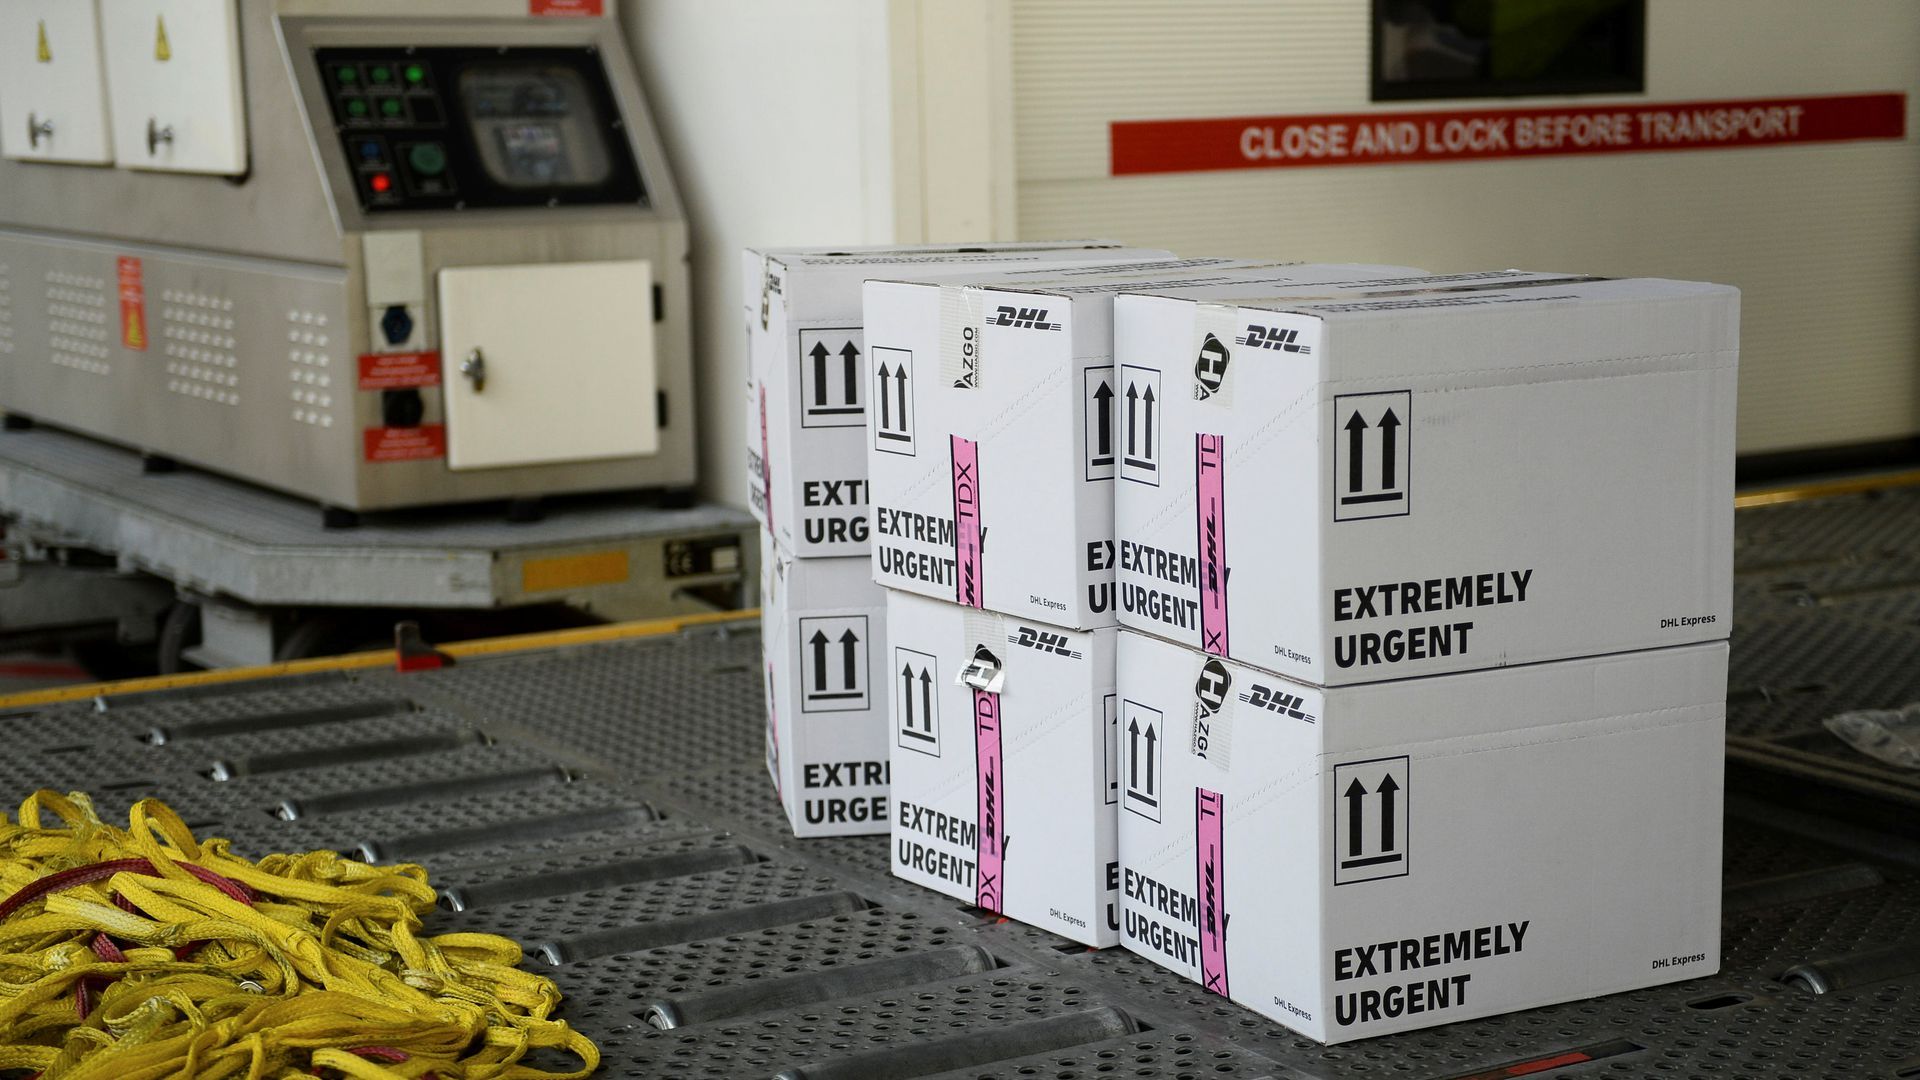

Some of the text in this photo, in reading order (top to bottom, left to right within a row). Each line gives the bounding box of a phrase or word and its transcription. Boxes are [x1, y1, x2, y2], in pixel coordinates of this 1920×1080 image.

[1240, 105, 1803, 160] CLOSE AND LOCK BEFORE TRANSPORT
[996, 305, 1052, 331] DHL
[1245, 324, 1302, 354] DHL
[956, 461, 974, 524] TDX
[877, 506, 988, 554] EXTREMY
[1206, 513, 1218, 593] DHL
[879, 545, 956, 587] URGENT
[1121, 539, 1232, 589] EXTREMY
[1030, 594, 1066, 611] DHL Express
[1122, 581, 1199, 631] URGENT
[1334, 569, 1533, 622] EXTREMELY
[1017, 626, 1072, 657] DHL
[1334, 621, 1474, 669] URGENT
[1660, 614, 1716, 628] DHL Express
[1274, 645, 1312, 665] DHL Express
[1247, 683, 1306, 720] DHL
[899, 800, 1010, 861] EXTREMY
[985, 770, 996, 843] DHL
[898, 839, 976, 888] URGENT
[1049, 908, 1086, 928] DHL Express
[1124, 867, 1231, 942] EXTREMY
[1205, 859, 1217, 937] DHL
[1125, 908, 1199, 967] URGENT
[1334, 920, 1530, 981] EXTREMELY
[1652, 953, 1705, 969] DHL Express
[1274, 996, 1312, 1021] DHL Express
[1335, 973, 1471, 1026] URGENT
